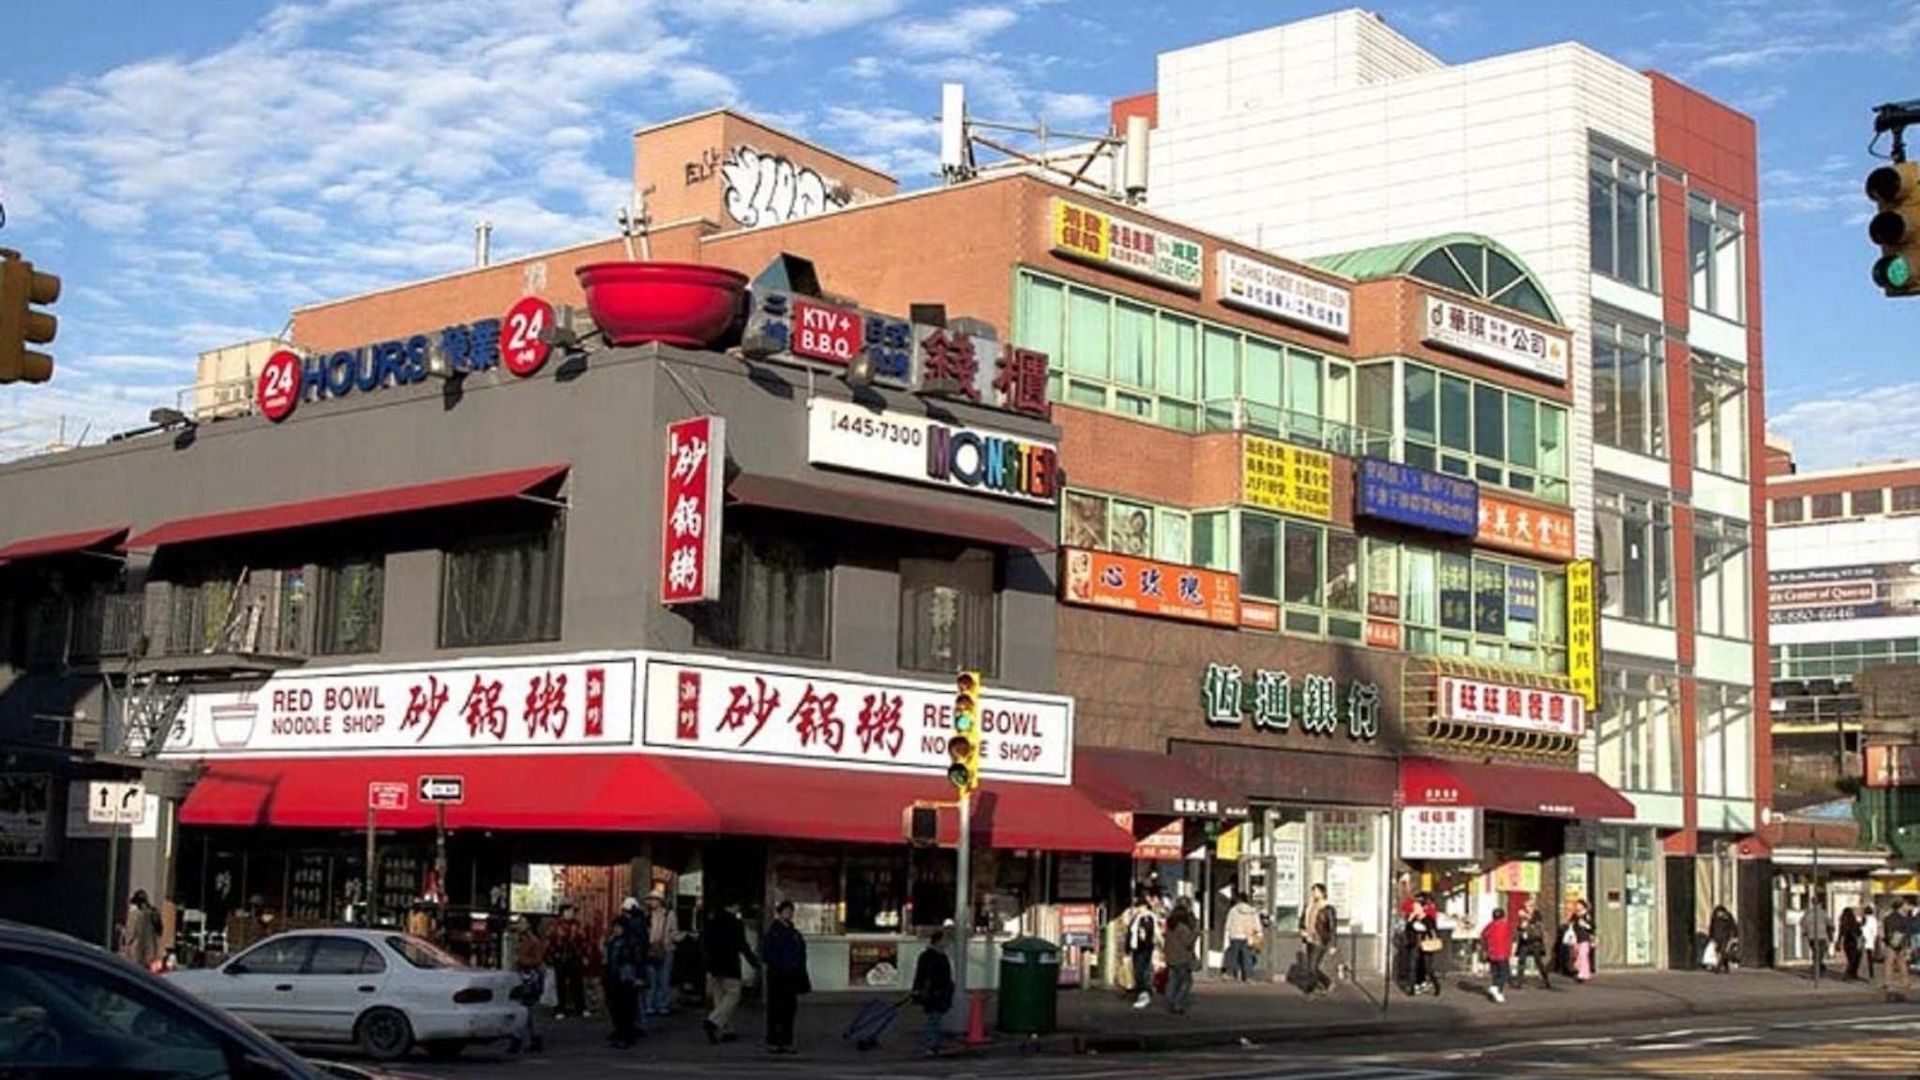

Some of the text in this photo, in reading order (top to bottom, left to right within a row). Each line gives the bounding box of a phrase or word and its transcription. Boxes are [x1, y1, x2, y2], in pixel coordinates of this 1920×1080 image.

[264, 361, 293, 397] 24
[303, 335, 428, 402] HOURS
[508, 309, 543, 350] 24
[273, 689, 313, 712] RED
[324, 686, 385, 711] BOWL
[272, 714, 385, 735] NOODLE SHOP
[923, 703, 955, 729] RE
[981, 708, 1042, 738] BOWL
[1000, 741, 1042, 762] SHOP
